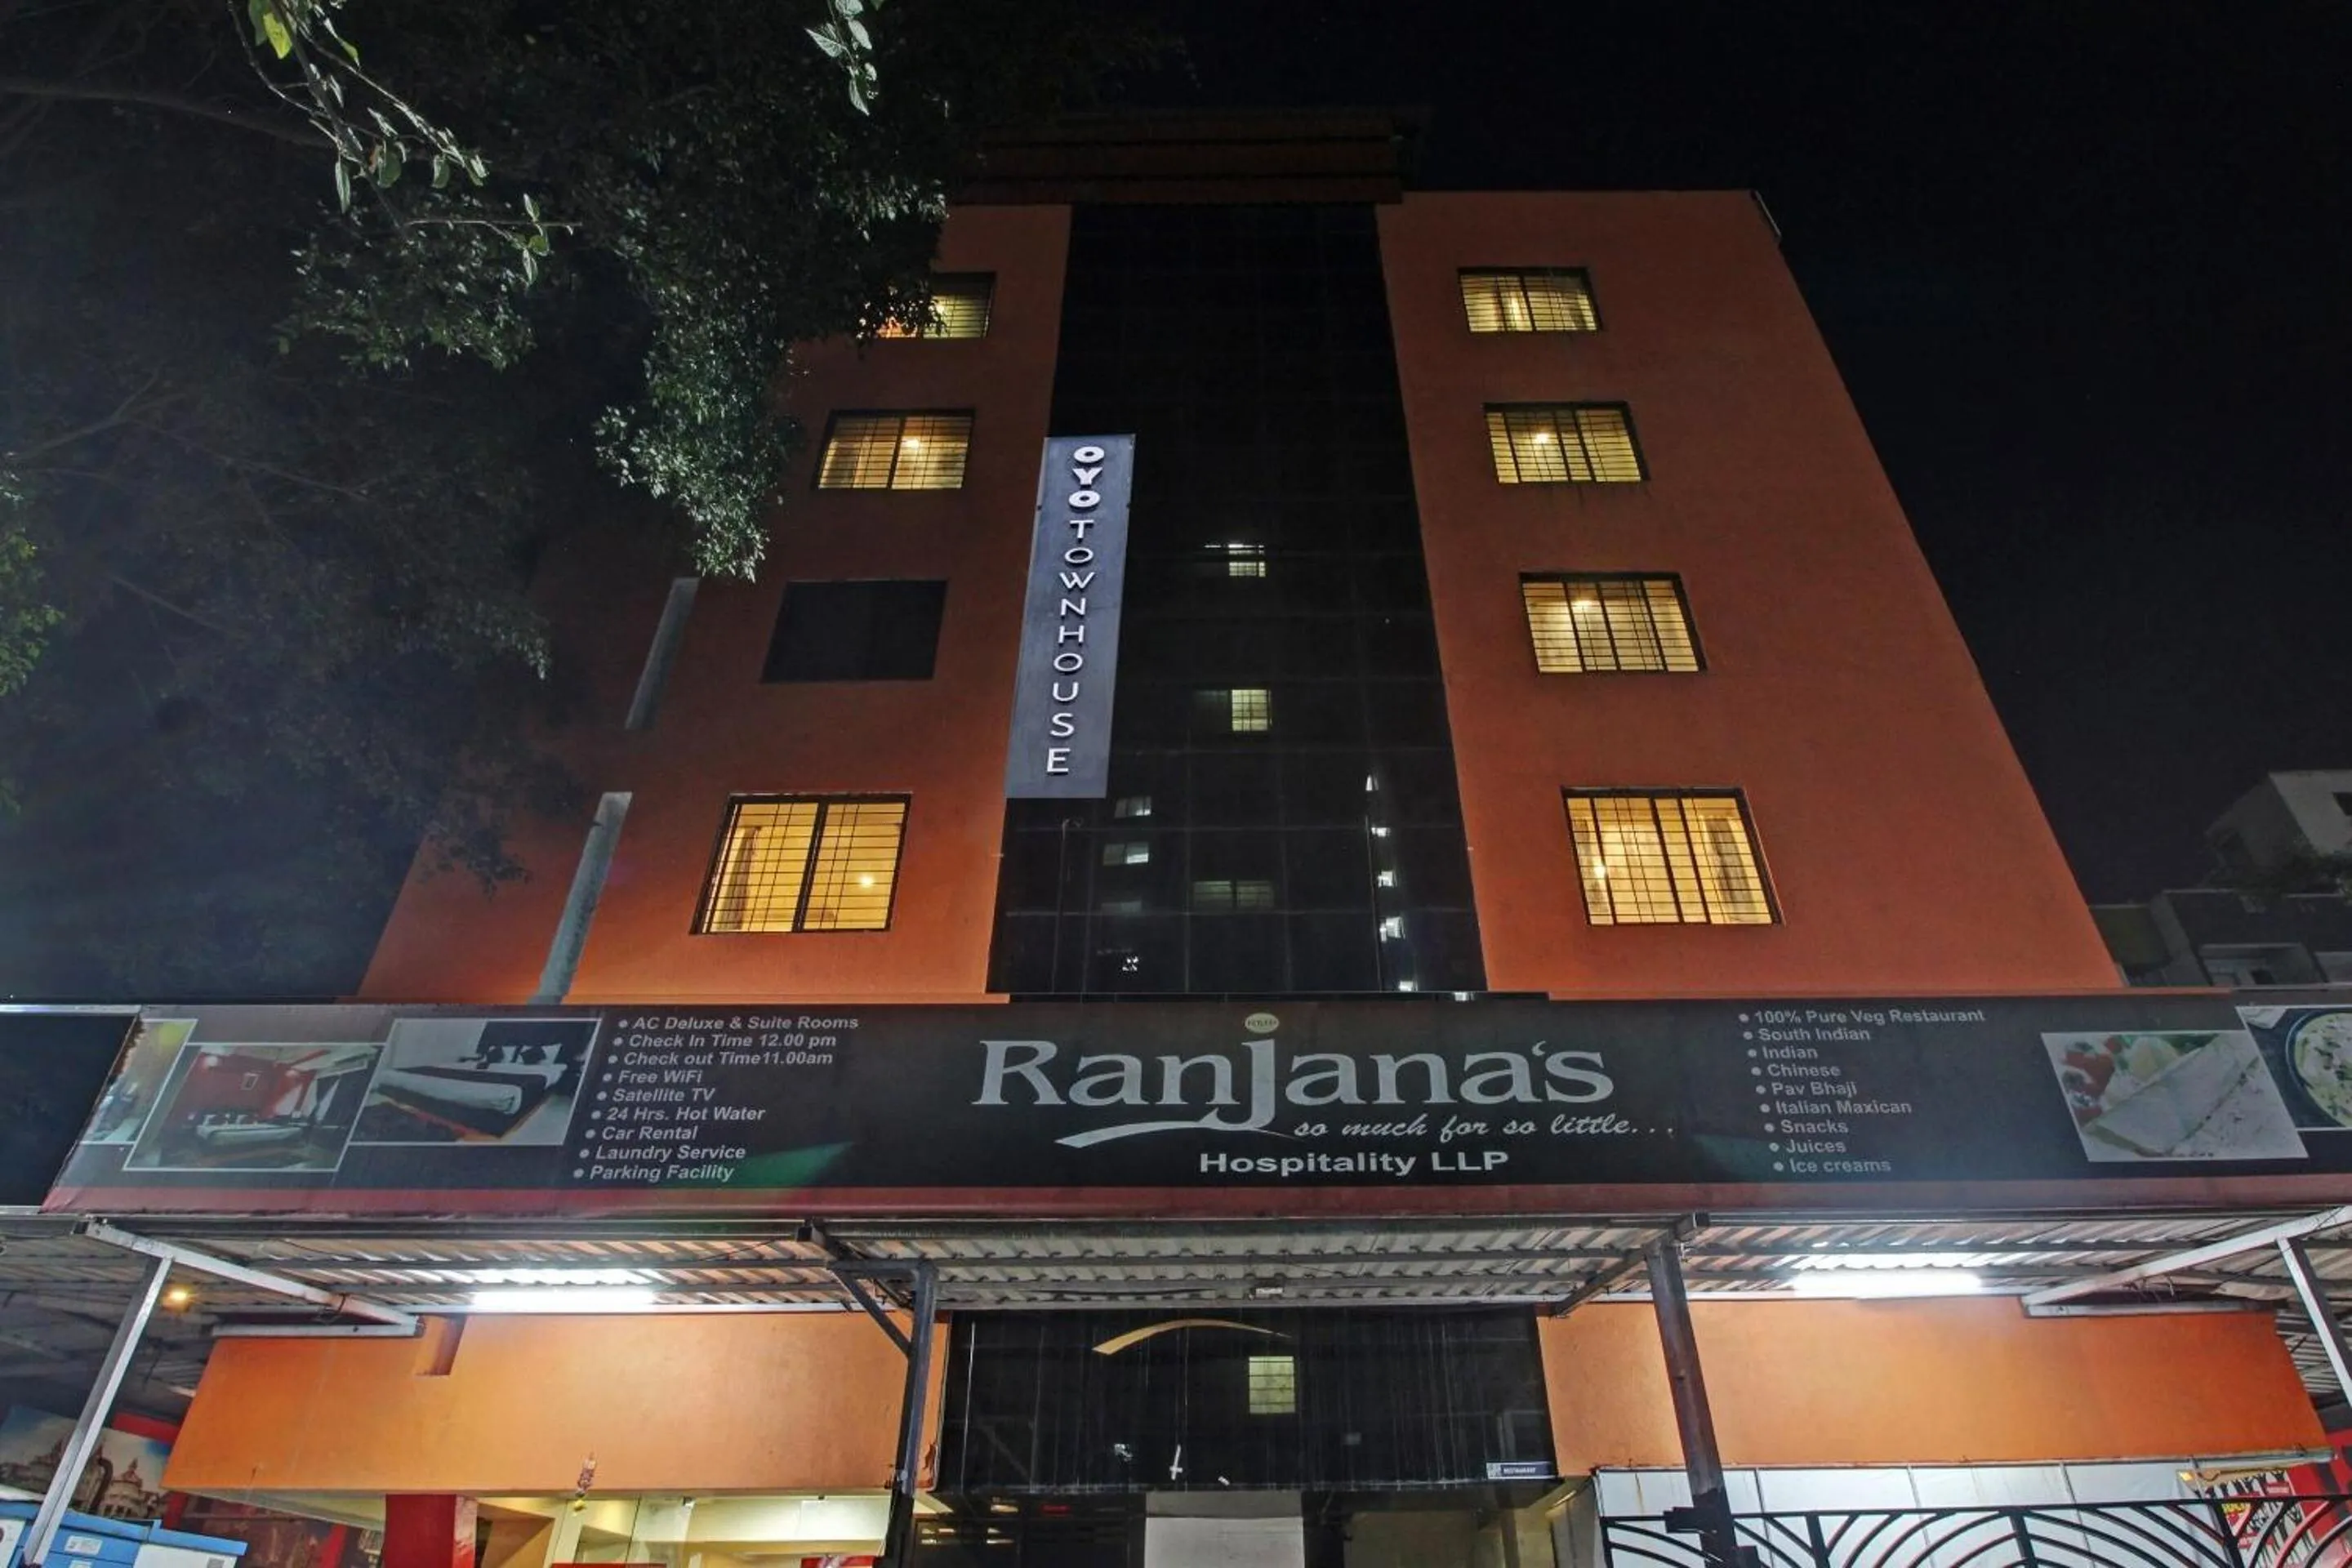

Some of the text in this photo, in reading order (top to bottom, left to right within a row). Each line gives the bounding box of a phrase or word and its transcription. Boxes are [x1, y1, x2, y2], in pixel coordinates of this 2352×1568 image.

[1046, 446, 1105, 773] OYO TOWNHOUSE
[633, 1016, 859, 1030] AC Deluxe & Suite Rooms
[1755, 1009, 1986, 1026] 100% Pure Veg Restaurant
[629, 1034, 837, 1049] Check In Time 12.00 pm
[1759, 1028, 1870, 1041] South Indian
[624, 1052, 679, 1066] Check
[684, 1053, 713, 1065] out
[1762, 1046, 1818, 1059] Indian
[618, 1070, 703, 1084] Free WiFi
[1767, 1064, 1841, 1077] Chinese
[612, 1088, 715, 1102] Satellite TV
[1771, 1081, 1858, 1098] Pav Bhaji
[606, 1107, 766, 1120] 24 Hrs. Hot Water
[1775, 1099, 1912, 1114] Italian Maxican
[602, 1125, 698, 1140] Car Rental
[1294, 1122, 1329, 1136] so
[1342, 1113, 1428, 1136] much
[1440, 1115, 1489, 1143] for
[1503, 1120, 1536, 1135] so
[1780, 1119, 1849, 1134] Snacks
[595, 1145, 746, 1162] Laundry Service
[1786, 1139, 1846, 1153] Juices
[1200, 1152, 1508, 1176] Hospitality LLP
[1789, 1158, 1891, 1173] Ice creams
[590, 1165, 735, 1183] Parking Facility
